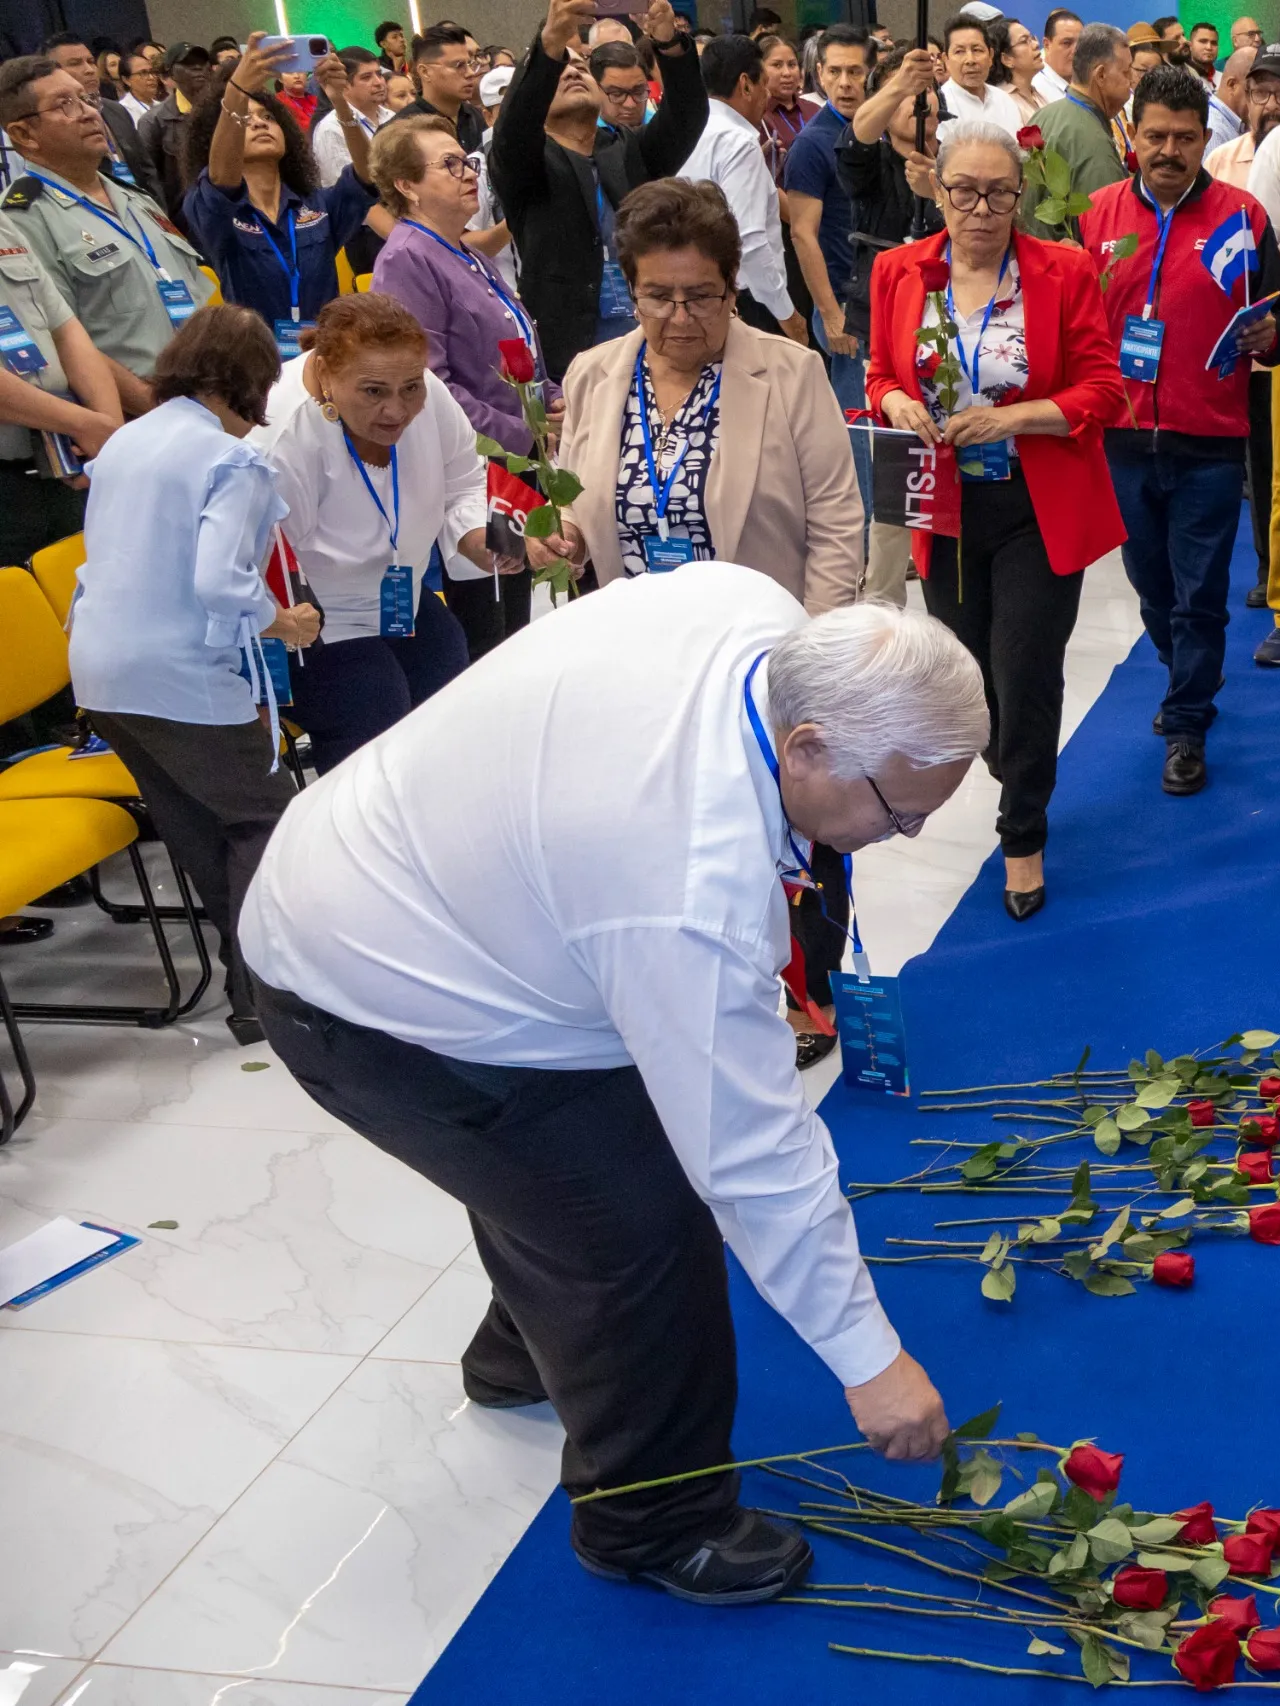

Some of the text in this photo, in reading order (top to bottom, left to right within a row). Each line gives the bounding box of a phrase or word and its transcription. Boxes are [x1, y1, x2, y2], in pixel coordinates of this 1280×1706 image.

[1101, 240, 1117, 254] FS
[905, 447, 937, 530] FSLN
[487, 495, 528, 537] FS
